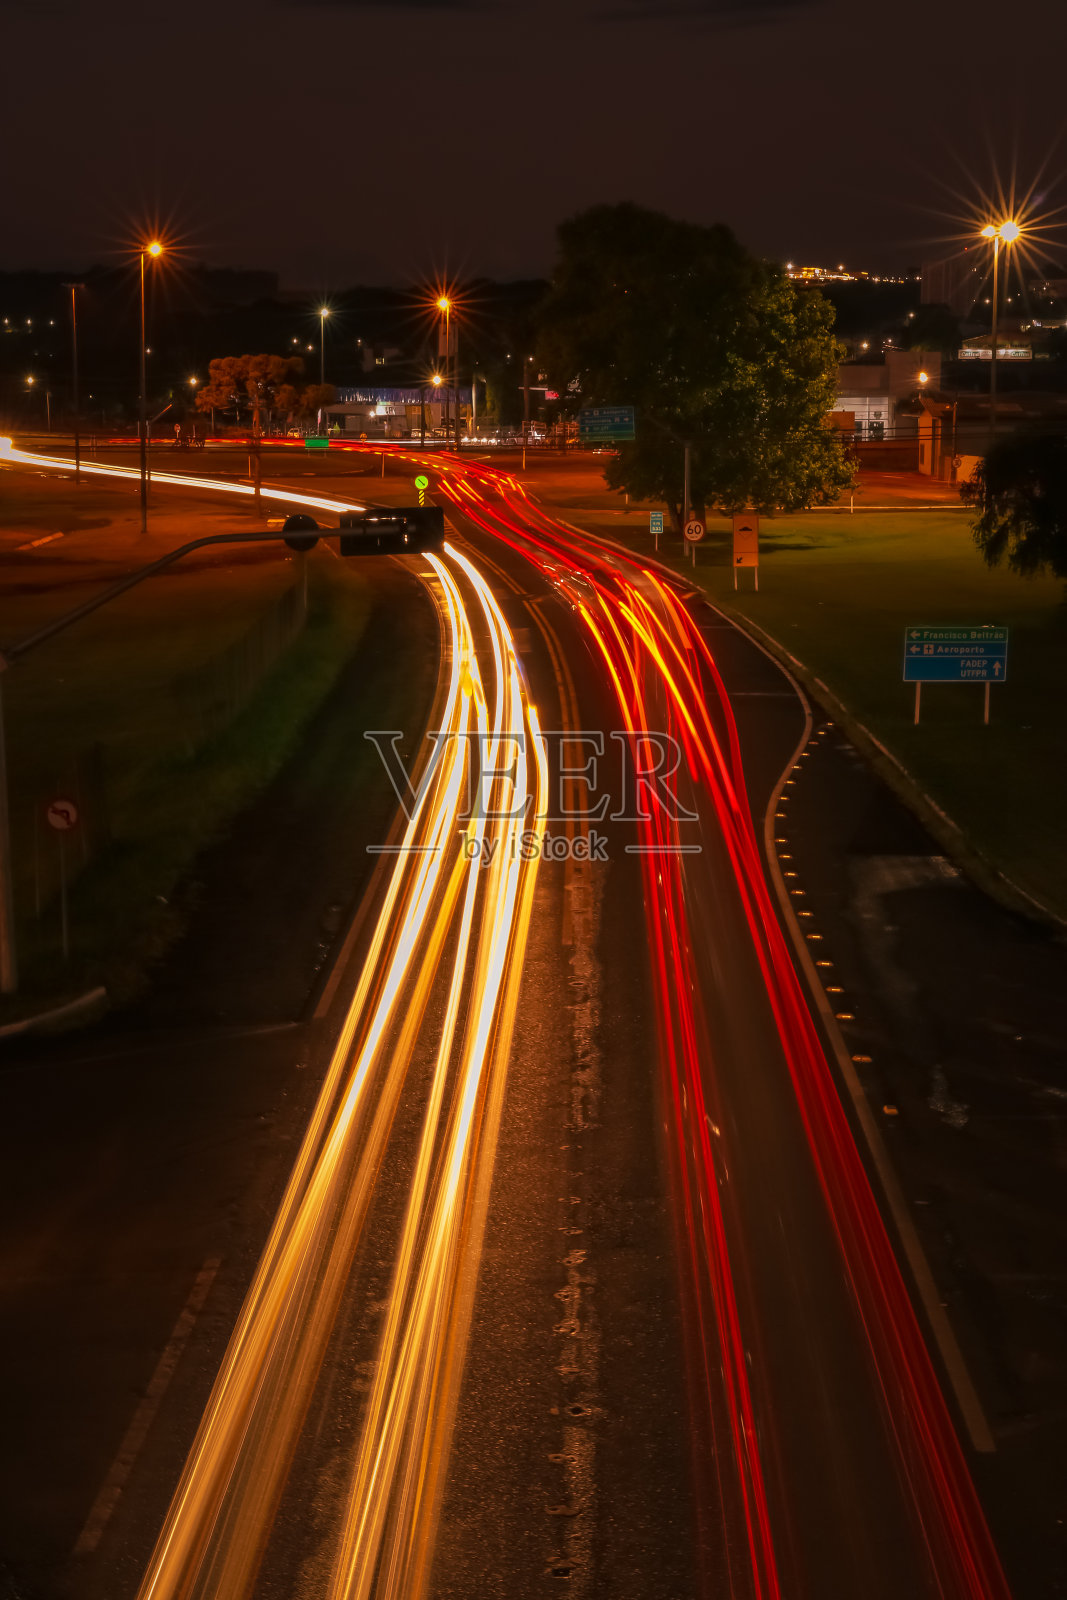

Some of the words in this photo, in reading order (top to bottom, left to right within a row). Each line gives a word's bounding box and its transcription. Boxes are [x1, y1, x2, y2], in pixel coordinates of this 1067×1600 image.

[687, 524, 702, 535] 60
[923, 631, 967, 639] Francisco
[937, 646, 985, 654] Aeroporto
[960, 660, 988, 668] FADEP
[960, 669, 988, 677] UTFPR
